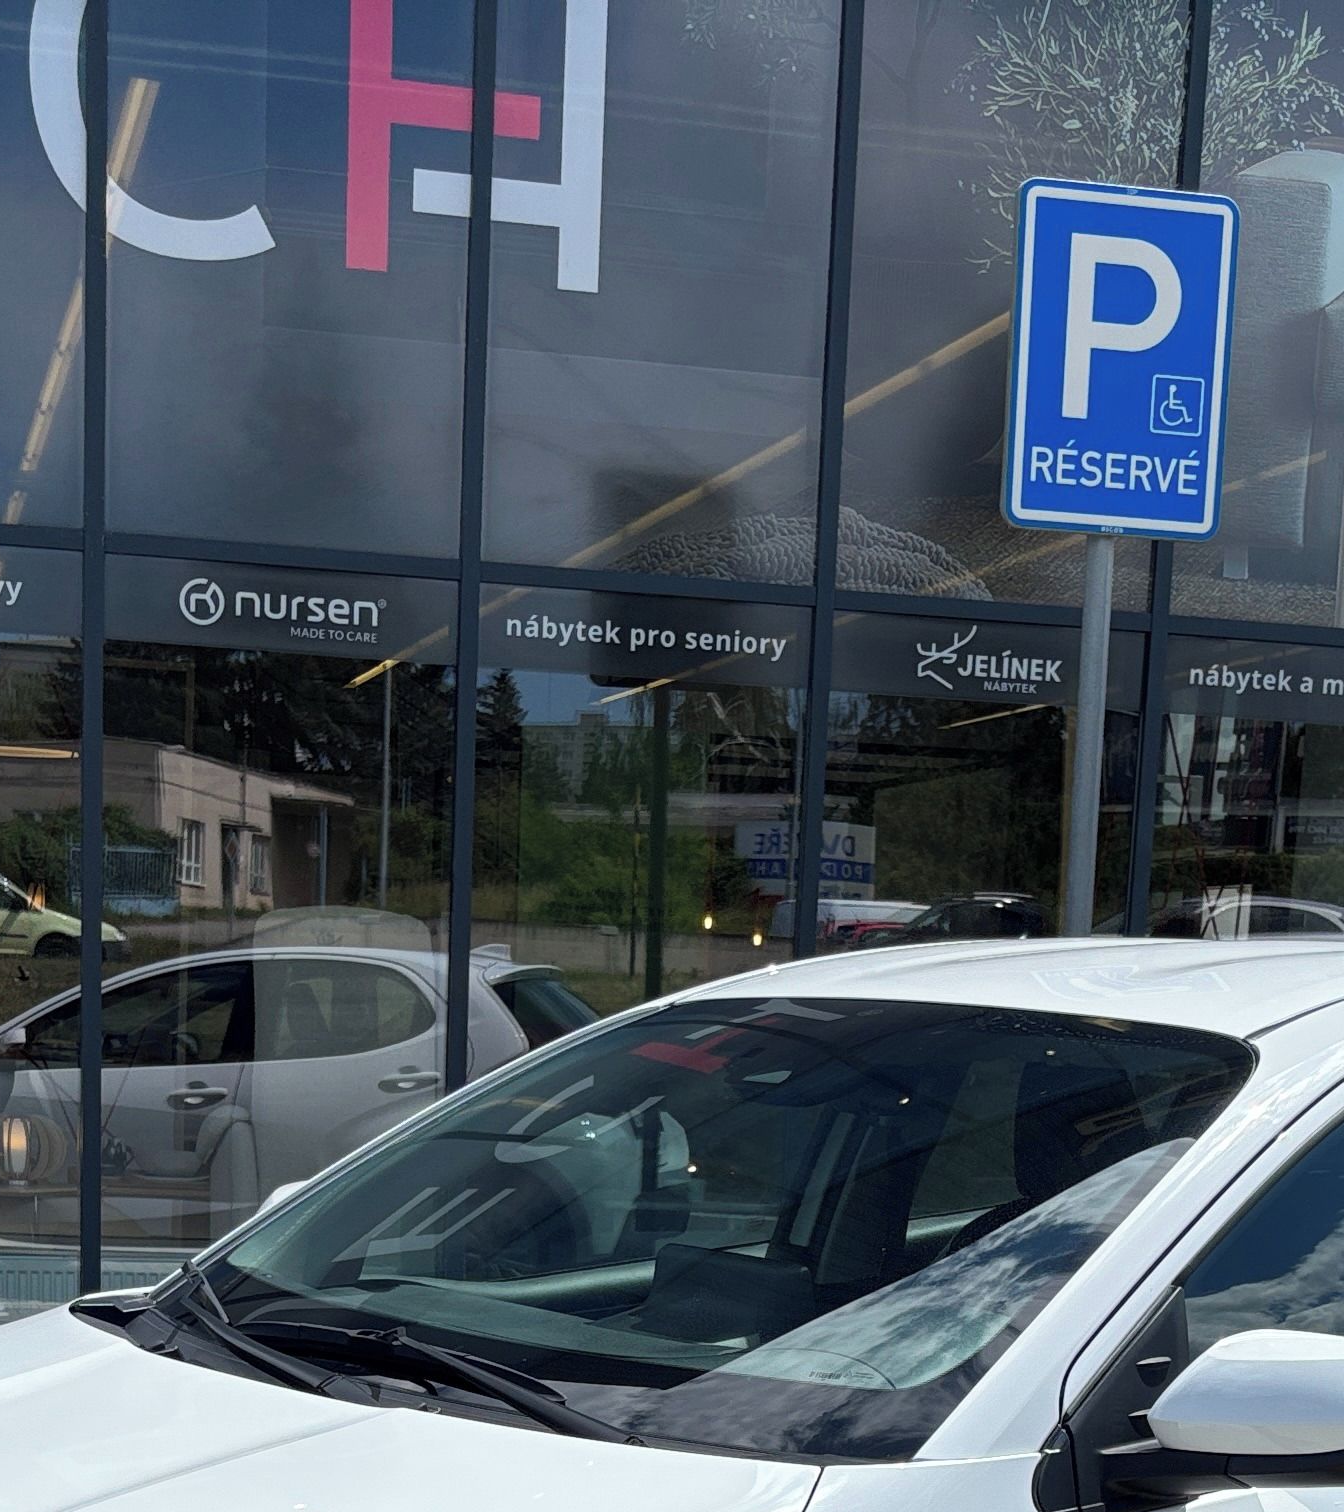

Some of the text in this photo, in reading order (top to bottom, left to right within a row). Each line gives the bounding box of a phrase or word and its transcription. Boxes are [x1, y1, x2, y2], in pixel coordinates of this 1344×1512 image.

[1062, 232, 1182, 419] P
[1030, 440, 1200, 495] RÉSERVÉ
[290, 626, 378, 644] MADE TO CARE
[505, 614, 787, 661] nábytek pro seniory
[957, 650, 1063, 683] JELÍNEK
[1189, 664, 1292, 695] nábytek
[1299, 675, 1313, 693] a
[983, 680, 1038, 694] NÁBYTEK
